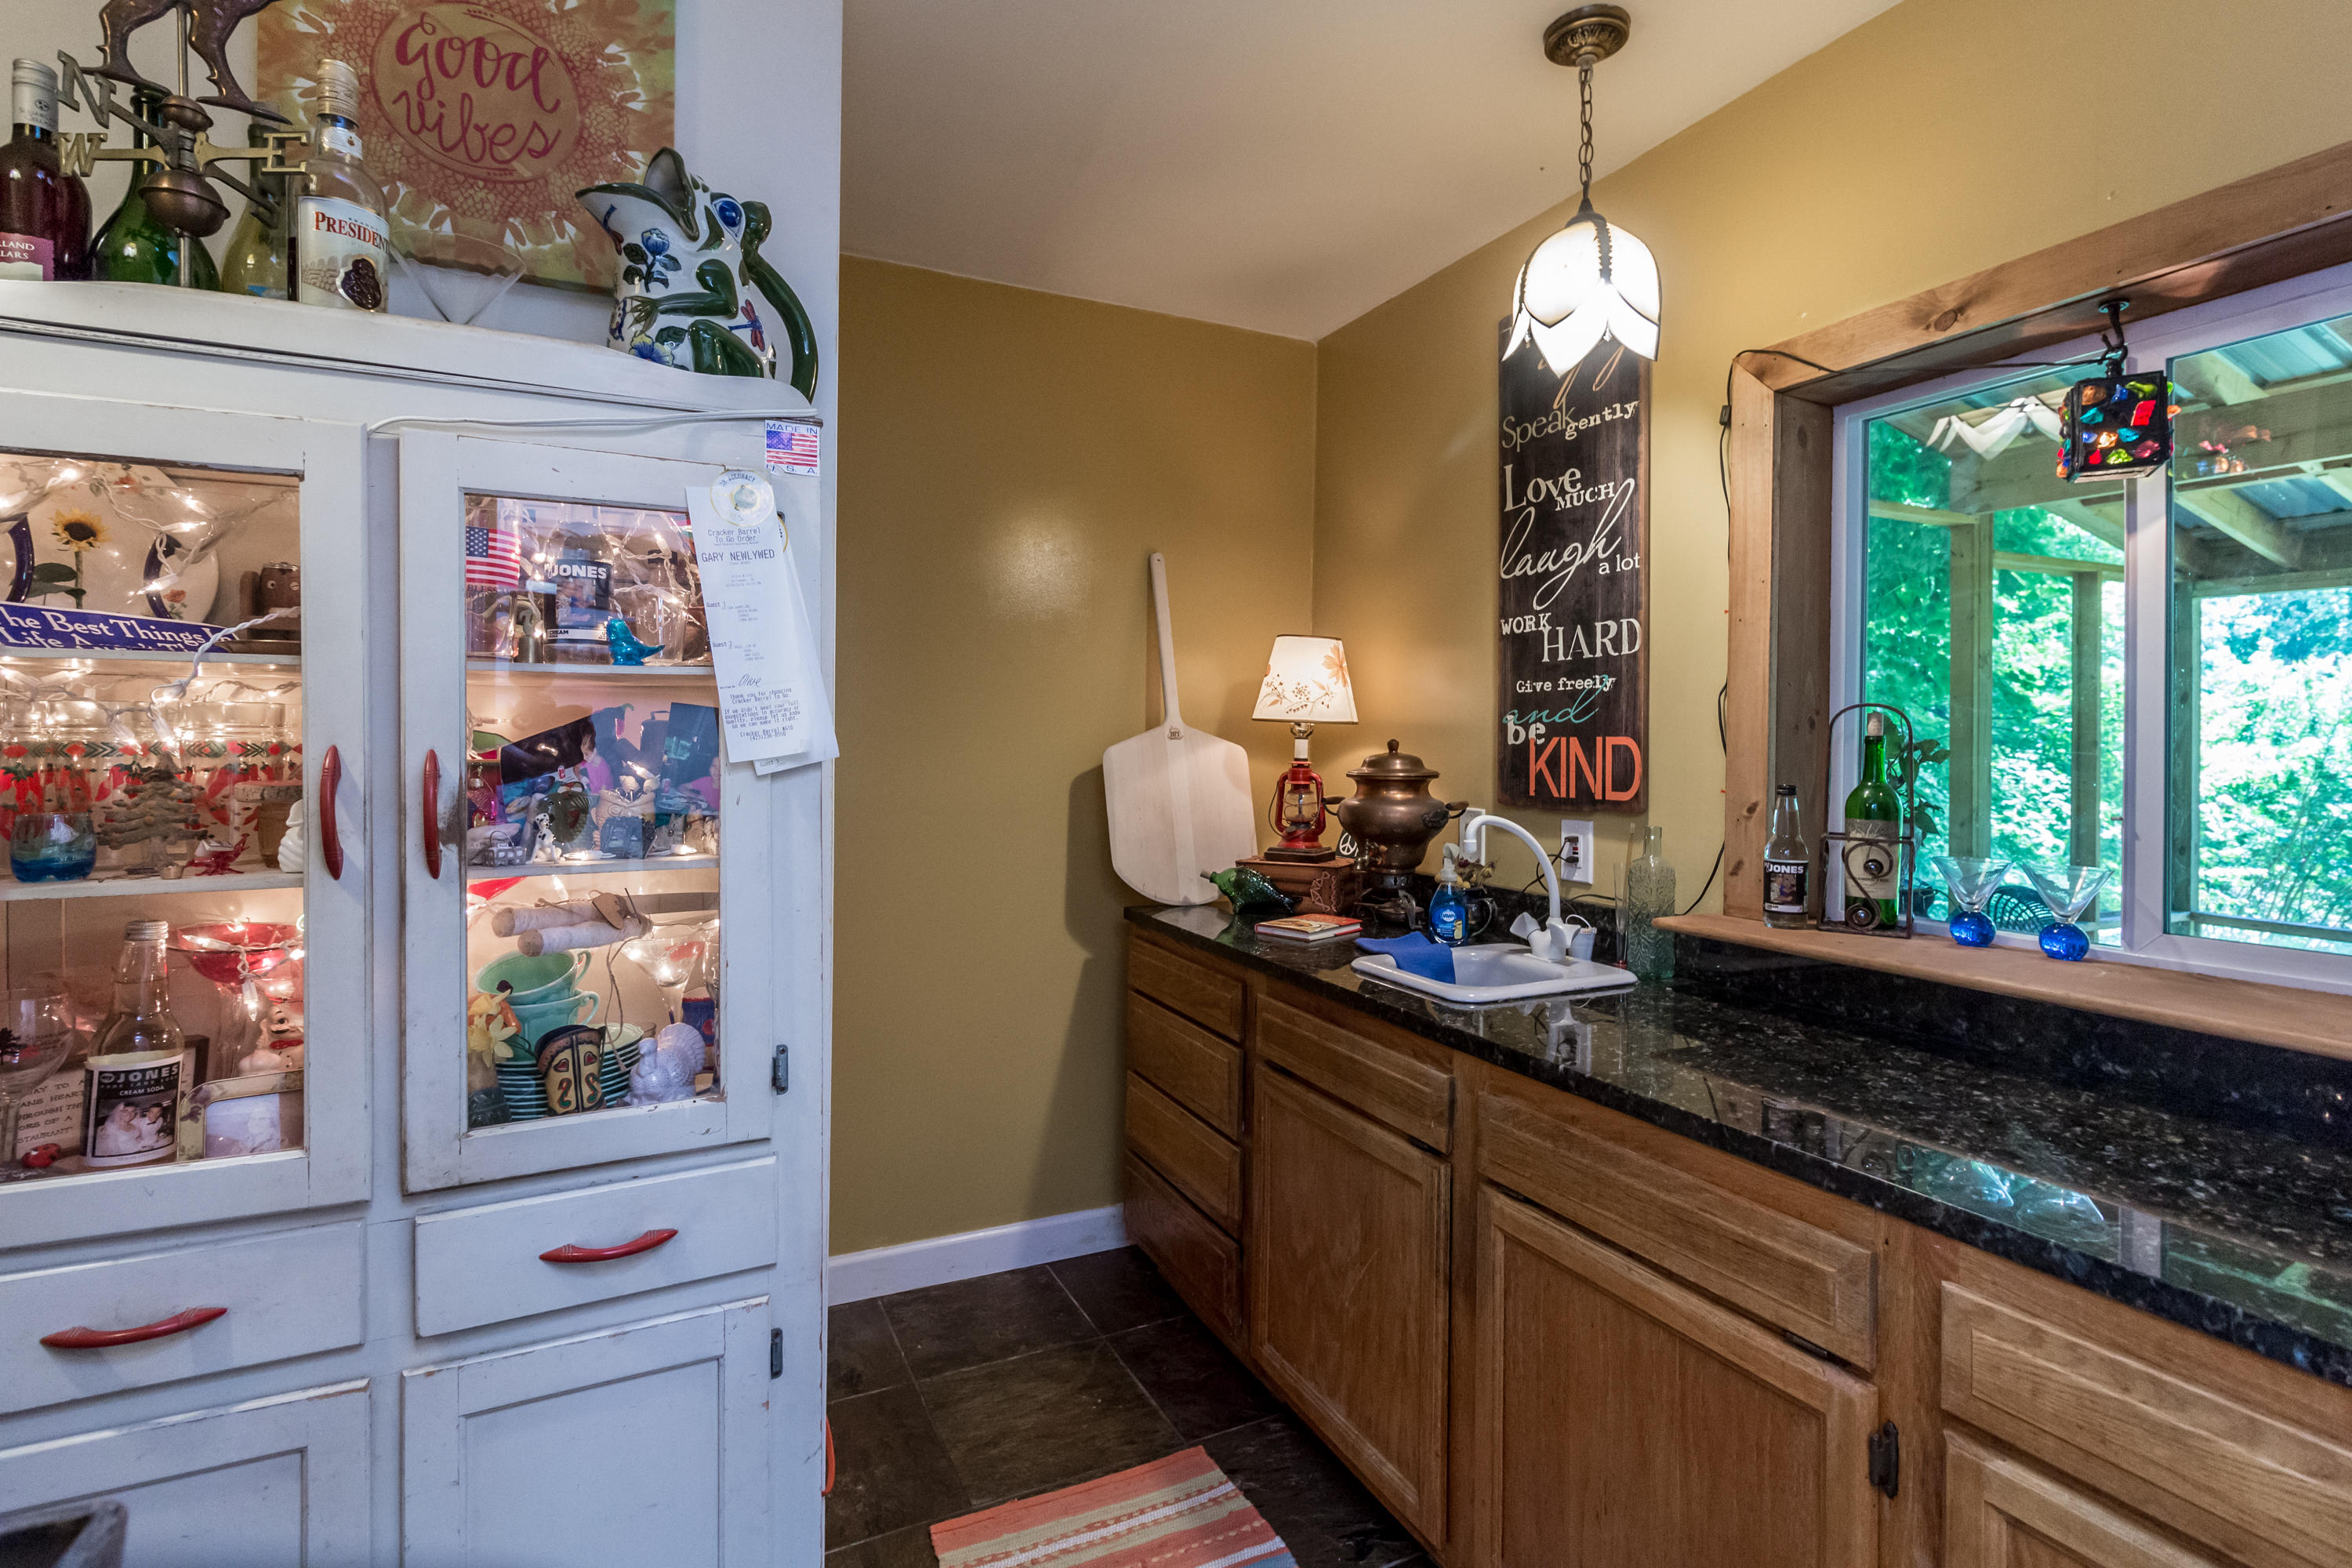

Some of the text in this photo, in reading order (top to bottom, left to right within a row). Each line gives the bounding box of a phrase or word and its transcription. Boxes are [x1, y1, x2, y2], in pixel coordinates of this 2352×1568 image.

[56, 49, 117, 129] N
[52, 132, 307, 177] W E
[0, 241, 34, 251] LAND
[767, 423, 801, 432] MADE
[1502, 397, 1639, 452] Speak gently
[1504, 464, 1582, 512] Love
[1555, 481, 1615, 511] MUCH
[1500, 477, 1635, 610] laugh
[702, 549, 775, 562] GARY NEWLYWED
[1599, 552, 1640, 575] a lot
[552, 564, 606, 579] JONES
[0, 606, 41, 628] he
[41, 611, 114, 636] Best
[110, 619, 205, 646] Things
[0, 627, 64, 648] Life
[1501, 612, 1642, 662] WORK HARD
[1516, 675, 1617, 693] Give freely
[1502, 674, 1609, 724] and
[1506, 714, 1546, 745] be
[1529, 736, 1642, 801] KIND
[1769, 864, 1804, 874] JONES
[118, 1065, 179, 1083] JONES
[18, 1106, 64, 1120] HROUGH
[16, 1126, 74, 1143] STAURANT
[18, 1122, 41, 1131] ORS
